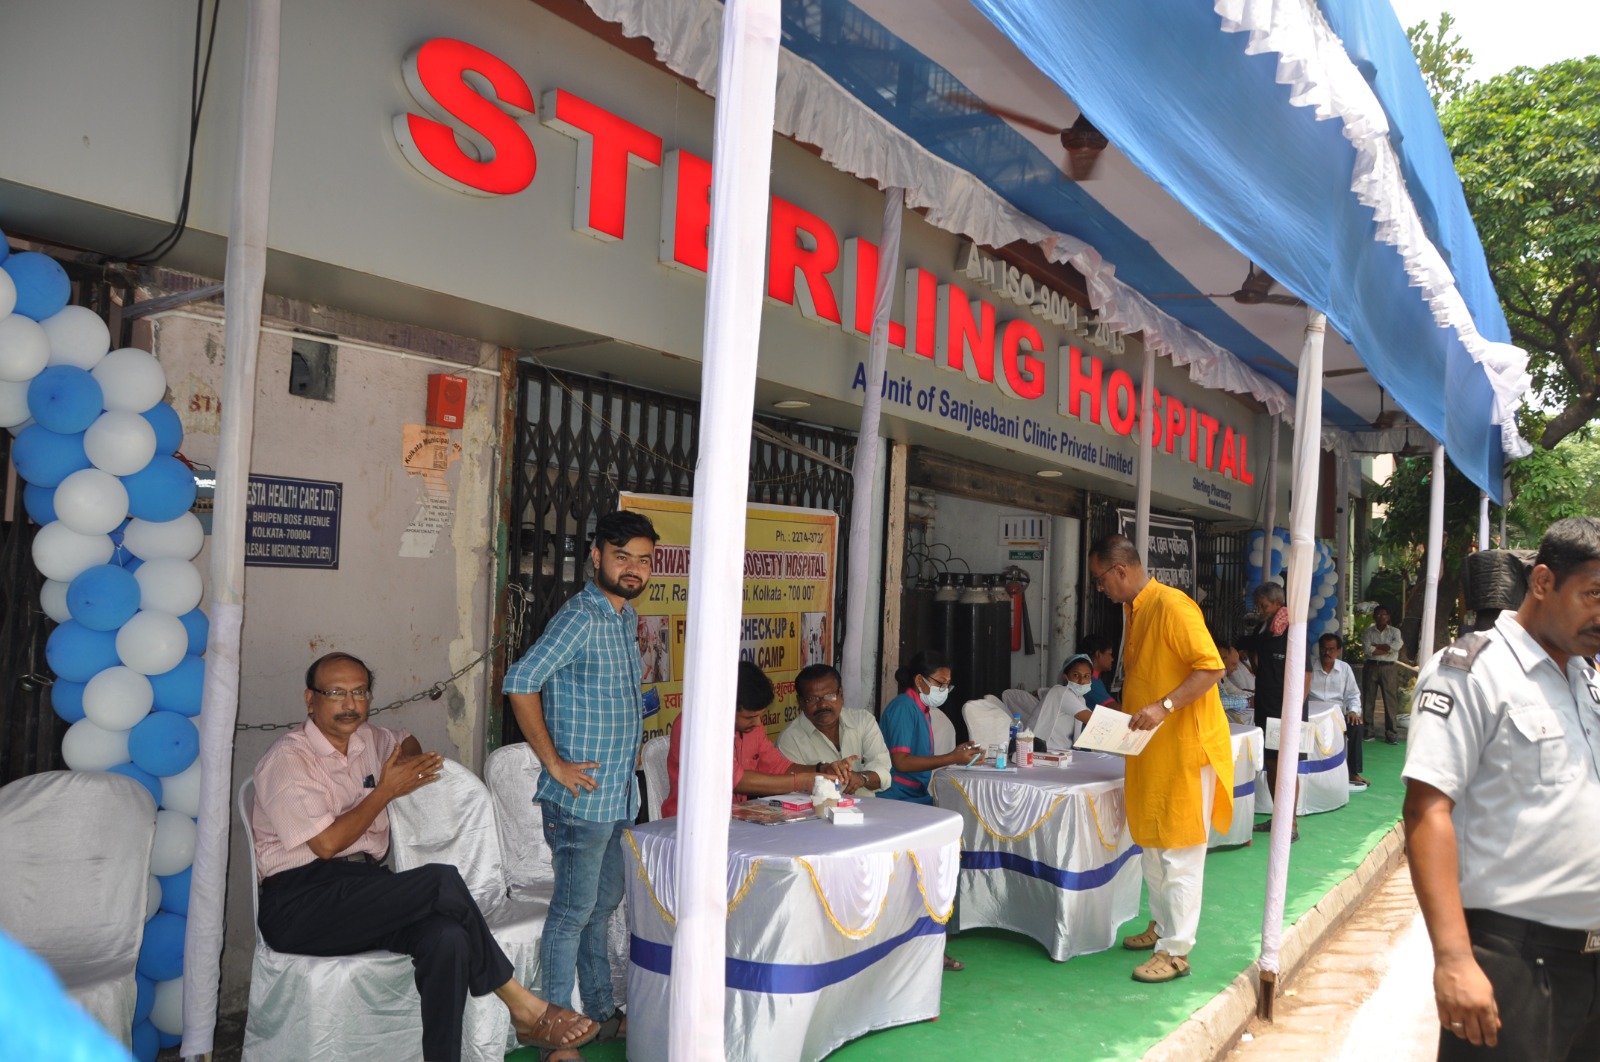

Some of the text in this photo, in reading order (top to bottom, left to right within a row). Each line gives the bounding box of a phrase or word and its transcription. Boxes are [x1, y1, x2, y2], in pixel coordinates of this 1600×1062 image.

[405, 37, 1254, 487] STERLING HOSPITAL
[964, 241, 996, 285] An
[851, 361, 867, 393] A
[917, 385, 936, 413] of
[938, 389, 1020, 440] Sanjeebani
[1022, 418, 1058, 451] Clinic
[1060, 431, 1097, 464] Private
[1099, 445, 1133, 475] Limited
[404, 442, 423, 464] Kolkata
[422, 435, 450, 446] Municipal
[268, 484, 298, 508] HEALTH
[299, 486, 319, 510] CARE
[320, 488, 336, 512] LTD.
[252, 511, 331, 527] BHUPEN BOSE AVENUE
[252, 526, 311, 540] KOLKATA-700004
[775, 529, 787, 542] Ph.
[271, 544, 300, 558] MEDICINE
[743, 551, 783, 578] SOCIETY
[785, 552, 827, 578] HOSPITAL
[649, 583, 669, 604] 227,
[672, 584, 689, 601] Ra
[752, 585, 782, 600] Kolkata
[788, 585, 801, 600] 700
[802, 585, 816, 600] 007
[740, 617, 787, 641] CHECK-UP
[789, 621, 795, 638] &
[757, 645, 785, 669] CAMP
[784, 705, 801, 723] 923
